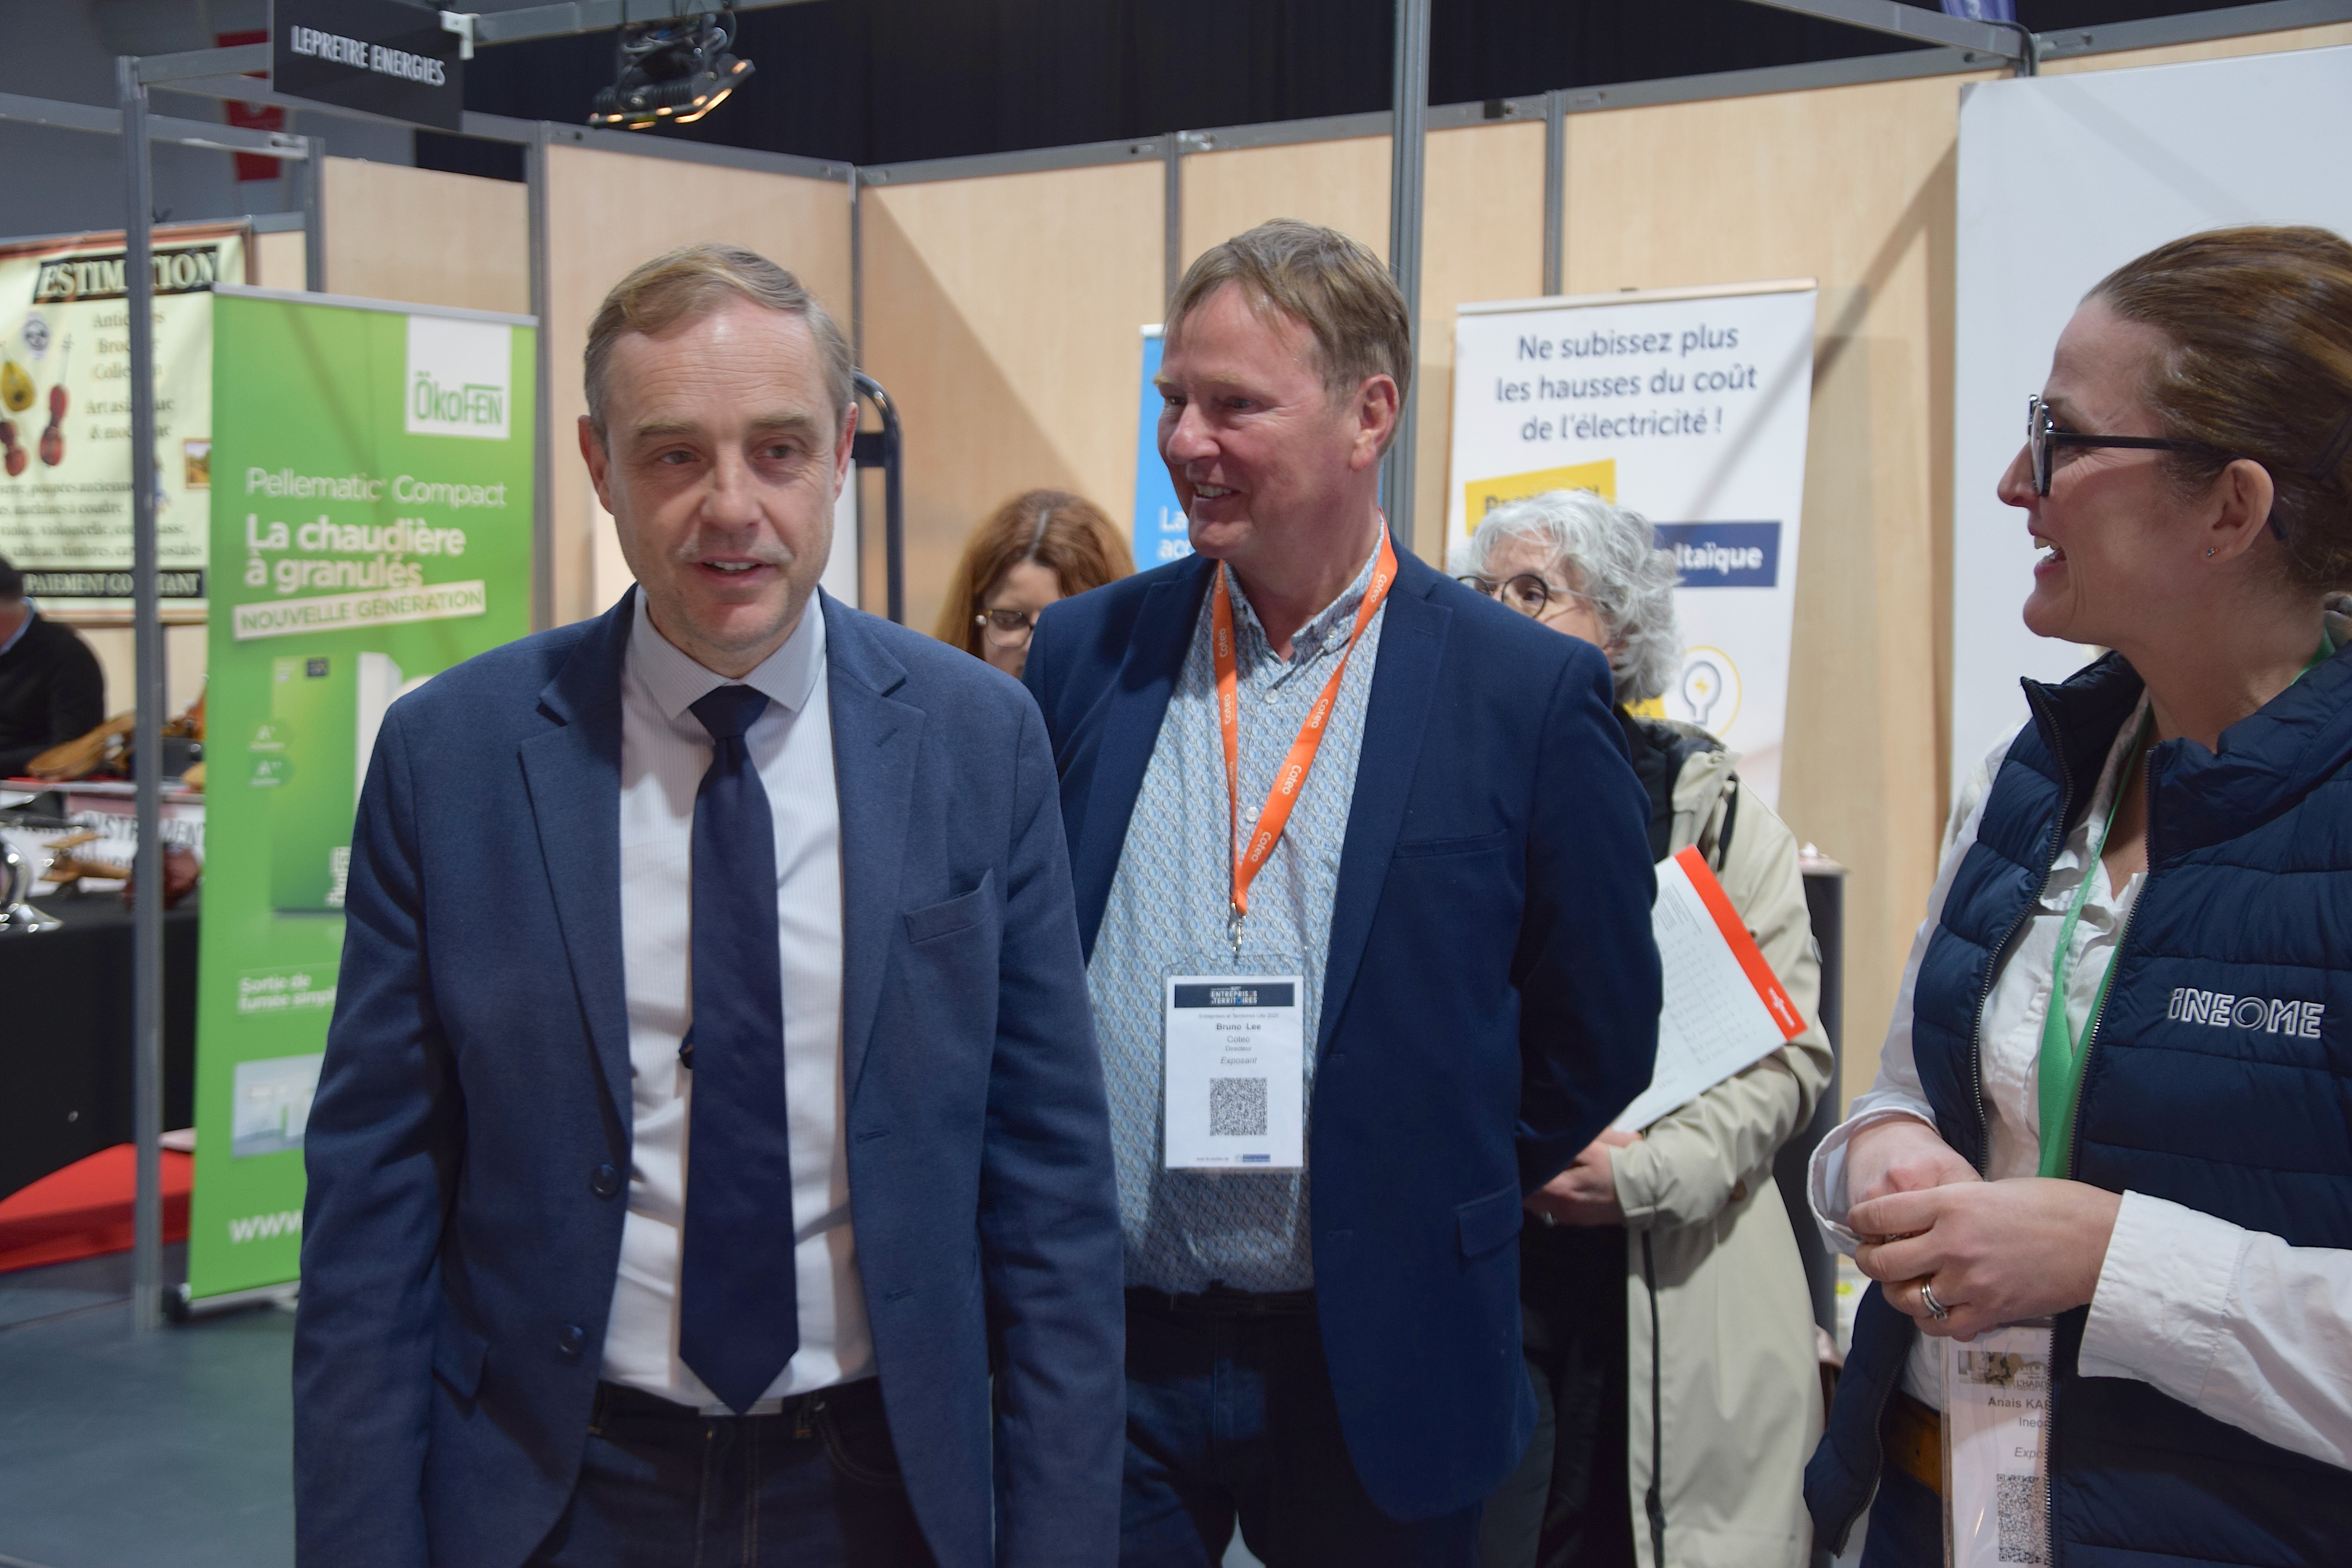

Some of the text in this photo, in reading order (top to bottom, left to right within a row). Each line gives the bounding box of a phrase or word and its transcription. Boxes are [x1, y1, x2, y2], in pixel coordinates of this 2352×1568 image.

[290, 25, 446, 87] LEPRETRE ENERGIES
[36, 251, 217, 298] ESTIMTION
[1518, 324, 1739, 360] Ne subissez plus
[1496, 363, 1758, 401] les hausses du coût
[1522, 408, 1723, 441] de l'électricité !
[392, 474, 508, 509] Compact
[246, 513, 466, 555] La chaudière
[1158, 505, 1187, 532] La
[106, 573, 201, 597] COTANT
[245, 550, 424, 594] à granulés
[1370, 573, 1388, 603] Coteo
[240, 601, 350, 631] NOUVELLE
[1220, 628, 1229, 658] Coteo
[1310, 698, 1329, 728] Coteo
[1282, 764, 1302, 795] Coteo
[1252, 831, 1272, 862] Coteo
[292, 985, 339, 1007] simpl
[1221, 1056, 1258, 1065] Exposant
[2014, 1446, 2049, 1460] Expo
